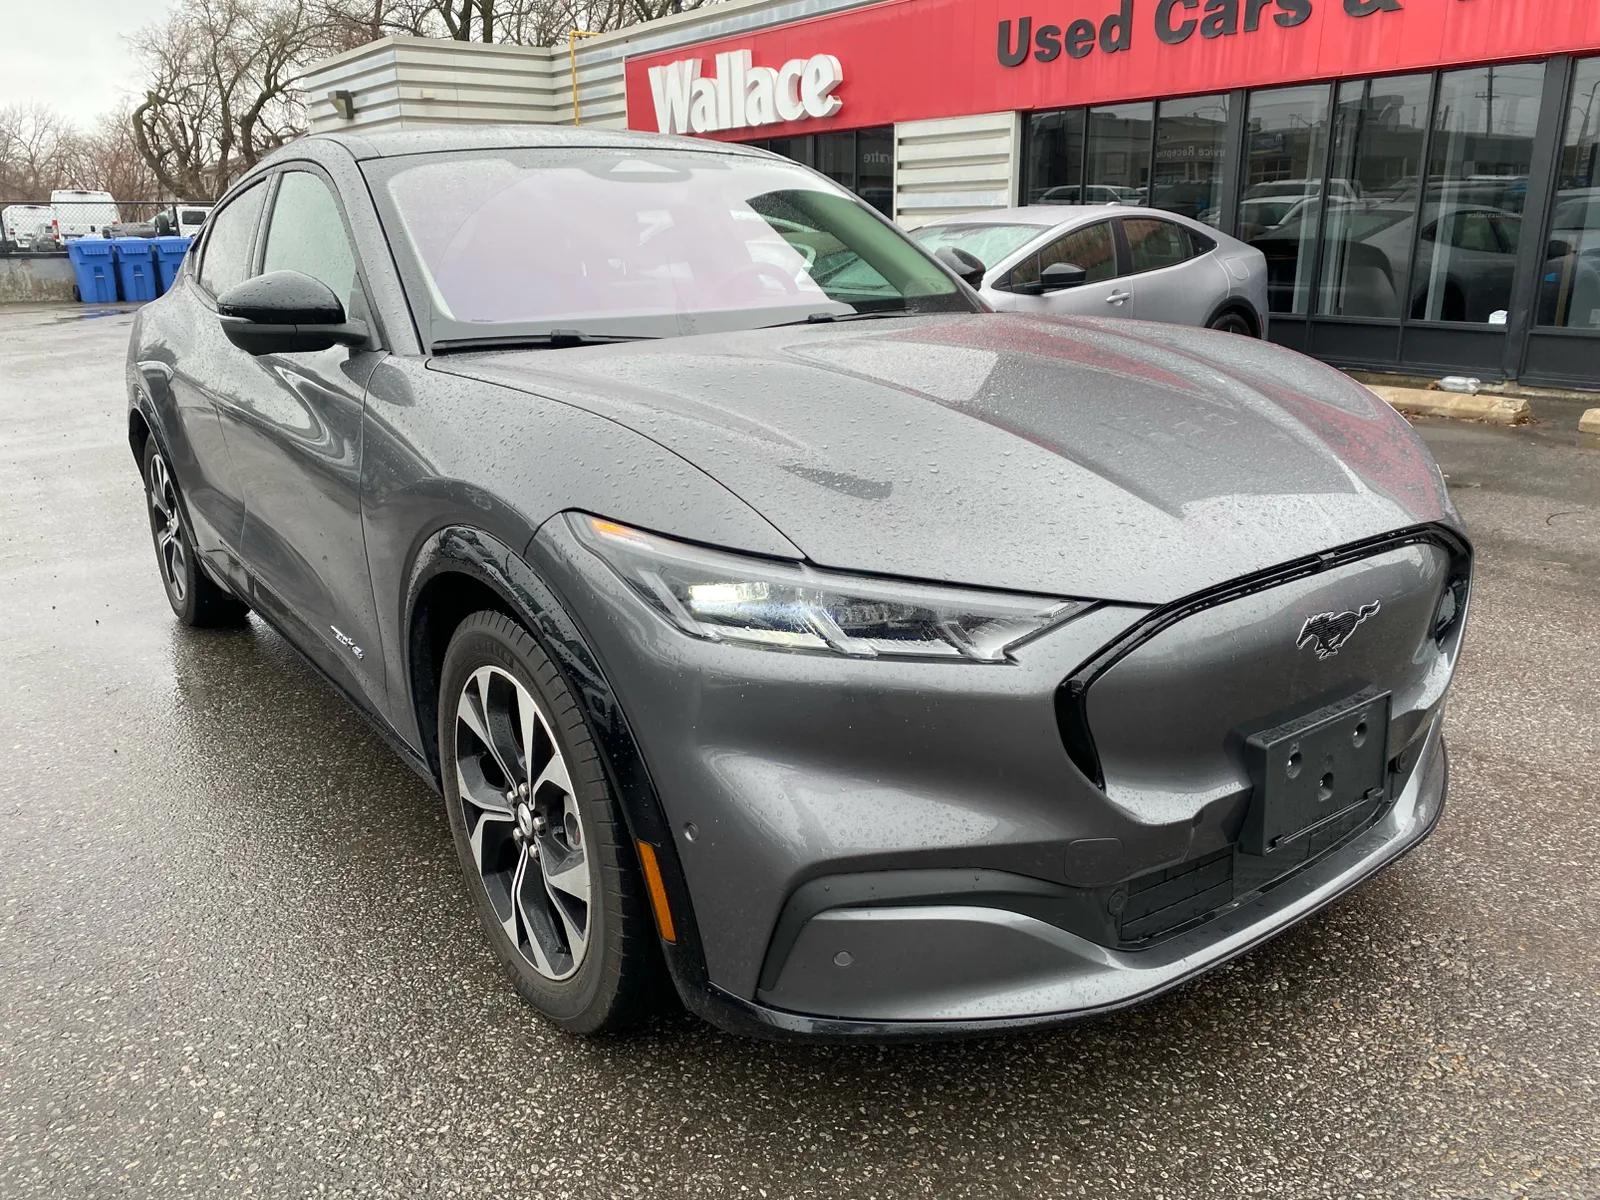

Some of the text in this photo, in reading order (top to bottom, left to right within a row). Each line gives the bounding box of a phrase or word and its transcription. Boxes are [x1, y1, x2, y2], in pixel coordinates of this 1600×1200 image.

[997, 0, 1312, 67] Used Cars
[648, 49, 843, 134] Wallace
